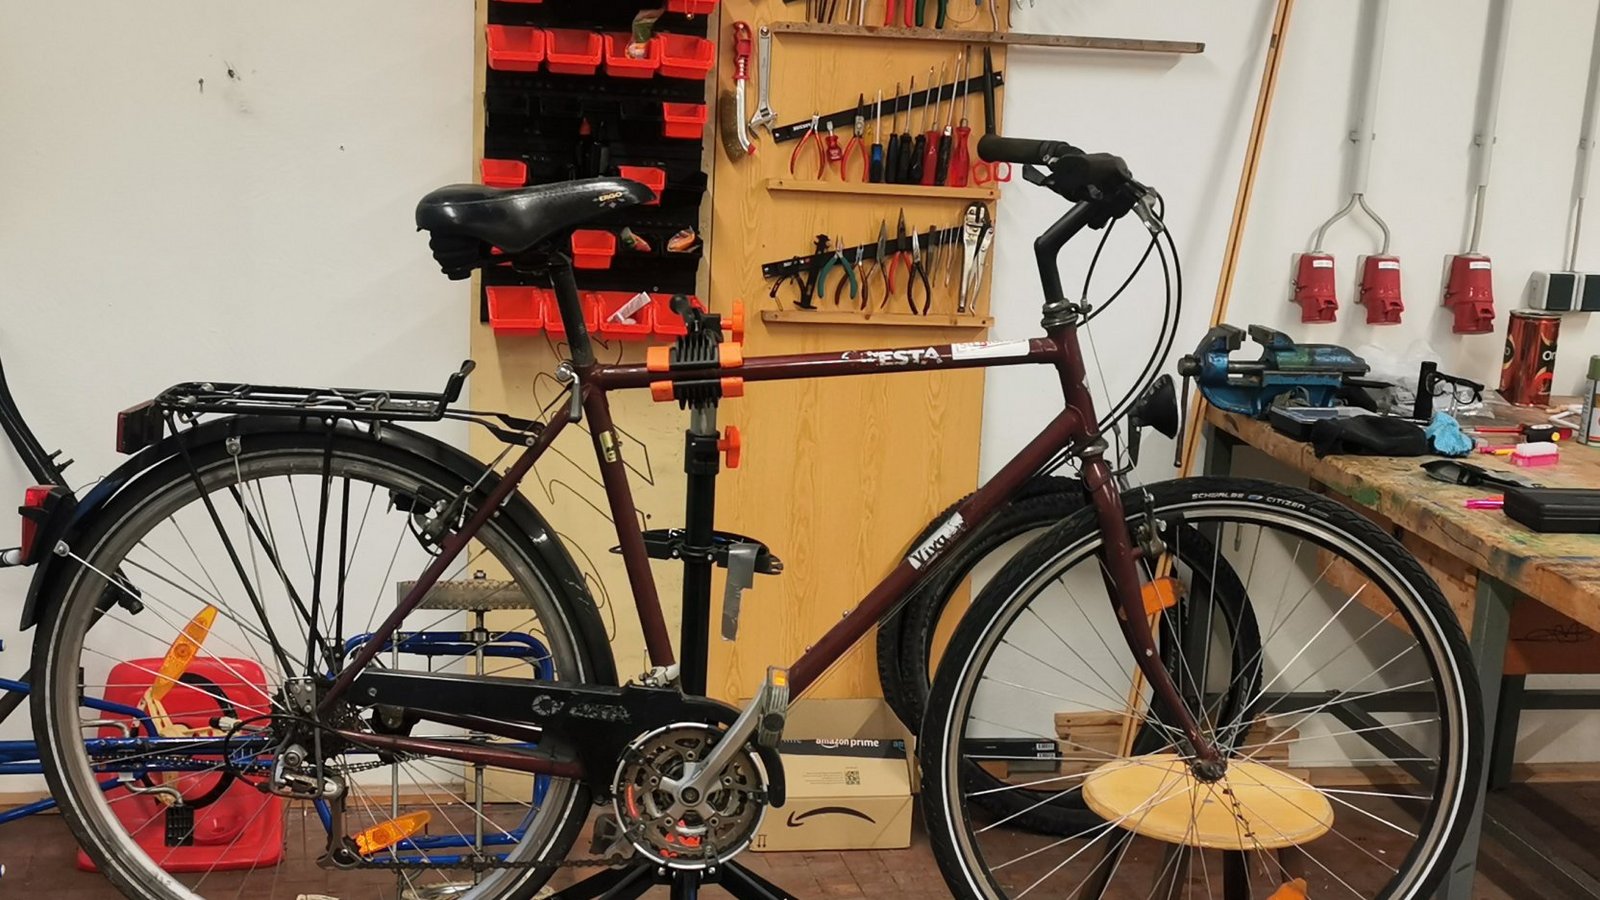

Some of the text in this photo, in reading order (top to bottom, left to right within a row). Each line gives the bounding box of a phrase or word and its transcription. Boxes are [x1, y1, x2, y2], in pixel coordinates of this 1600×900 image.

[599, 191, 623, 201] ERGO
[1191, 492, 1306, 510] SCHWALBE CITIZEN
[815, 738, 880, 749] amazon prime
